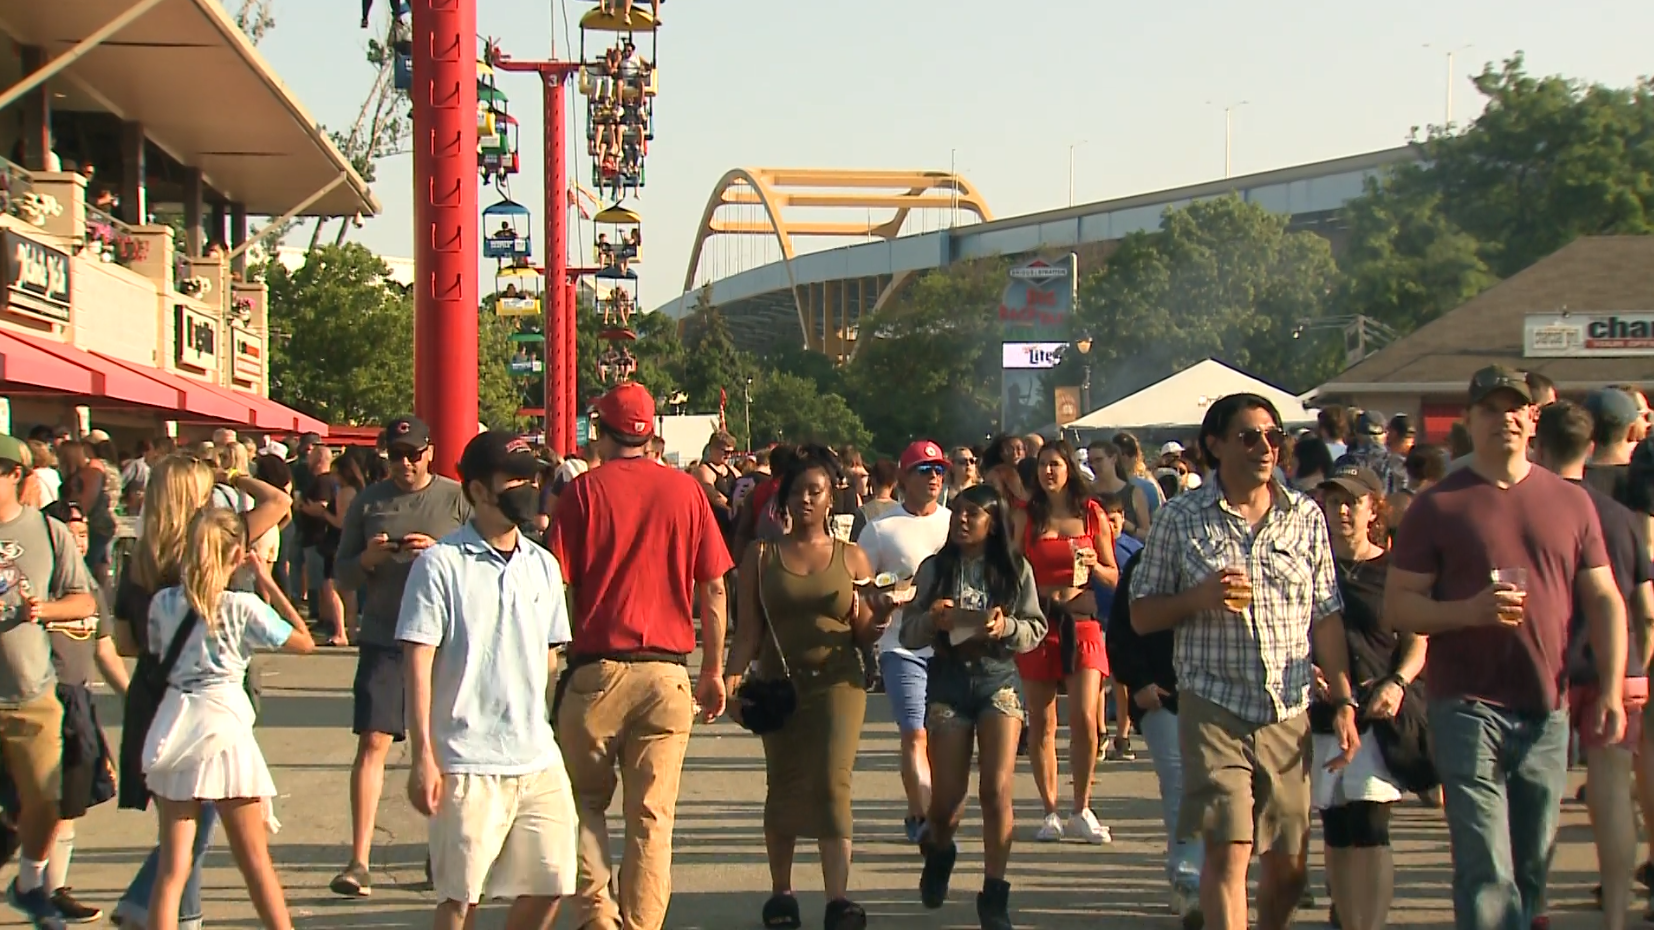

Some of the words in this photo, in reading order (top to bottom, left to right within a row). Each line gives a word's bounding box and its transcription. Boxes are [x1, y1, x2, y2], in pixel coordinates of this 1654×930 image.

[549, 74, 557, 87] 3
[1588, 316, 1654, 339] cha
[1029, 349, 1054, 364] Lite
